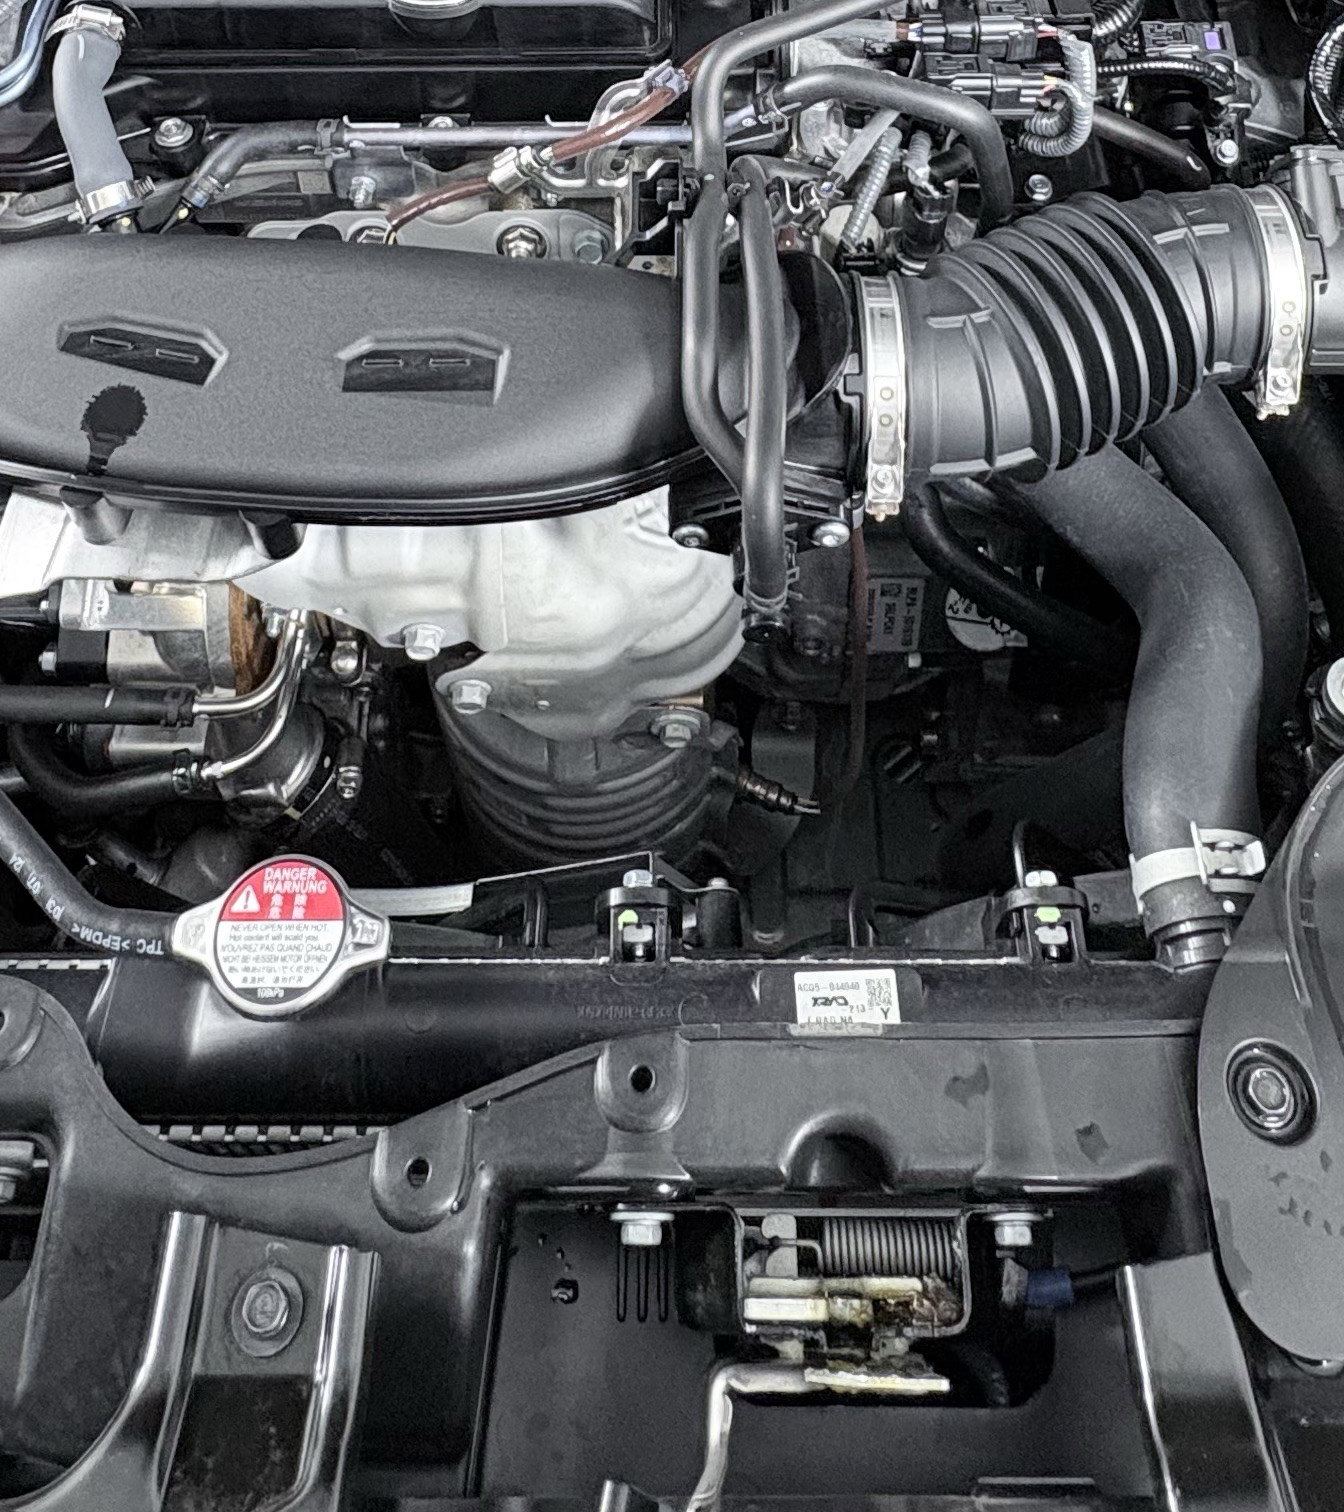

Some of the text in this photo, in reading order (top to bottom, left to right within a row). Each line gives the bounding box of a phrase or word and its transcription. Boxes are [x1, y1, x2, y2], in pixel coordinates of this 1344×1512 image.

[264, 867, 318, 880] DANGER
[263, 879, 328, 894] WARNUNG
[231, 923, 259, 932] NEVER
[260, 923, 283, 932] OPEN
[71, 925, 131, 952] >EPDM<
[133, 938, 165, 956] TPC
[277, 944, 304, 953] QUAND
[880, 1007, 890, 1020] Y
